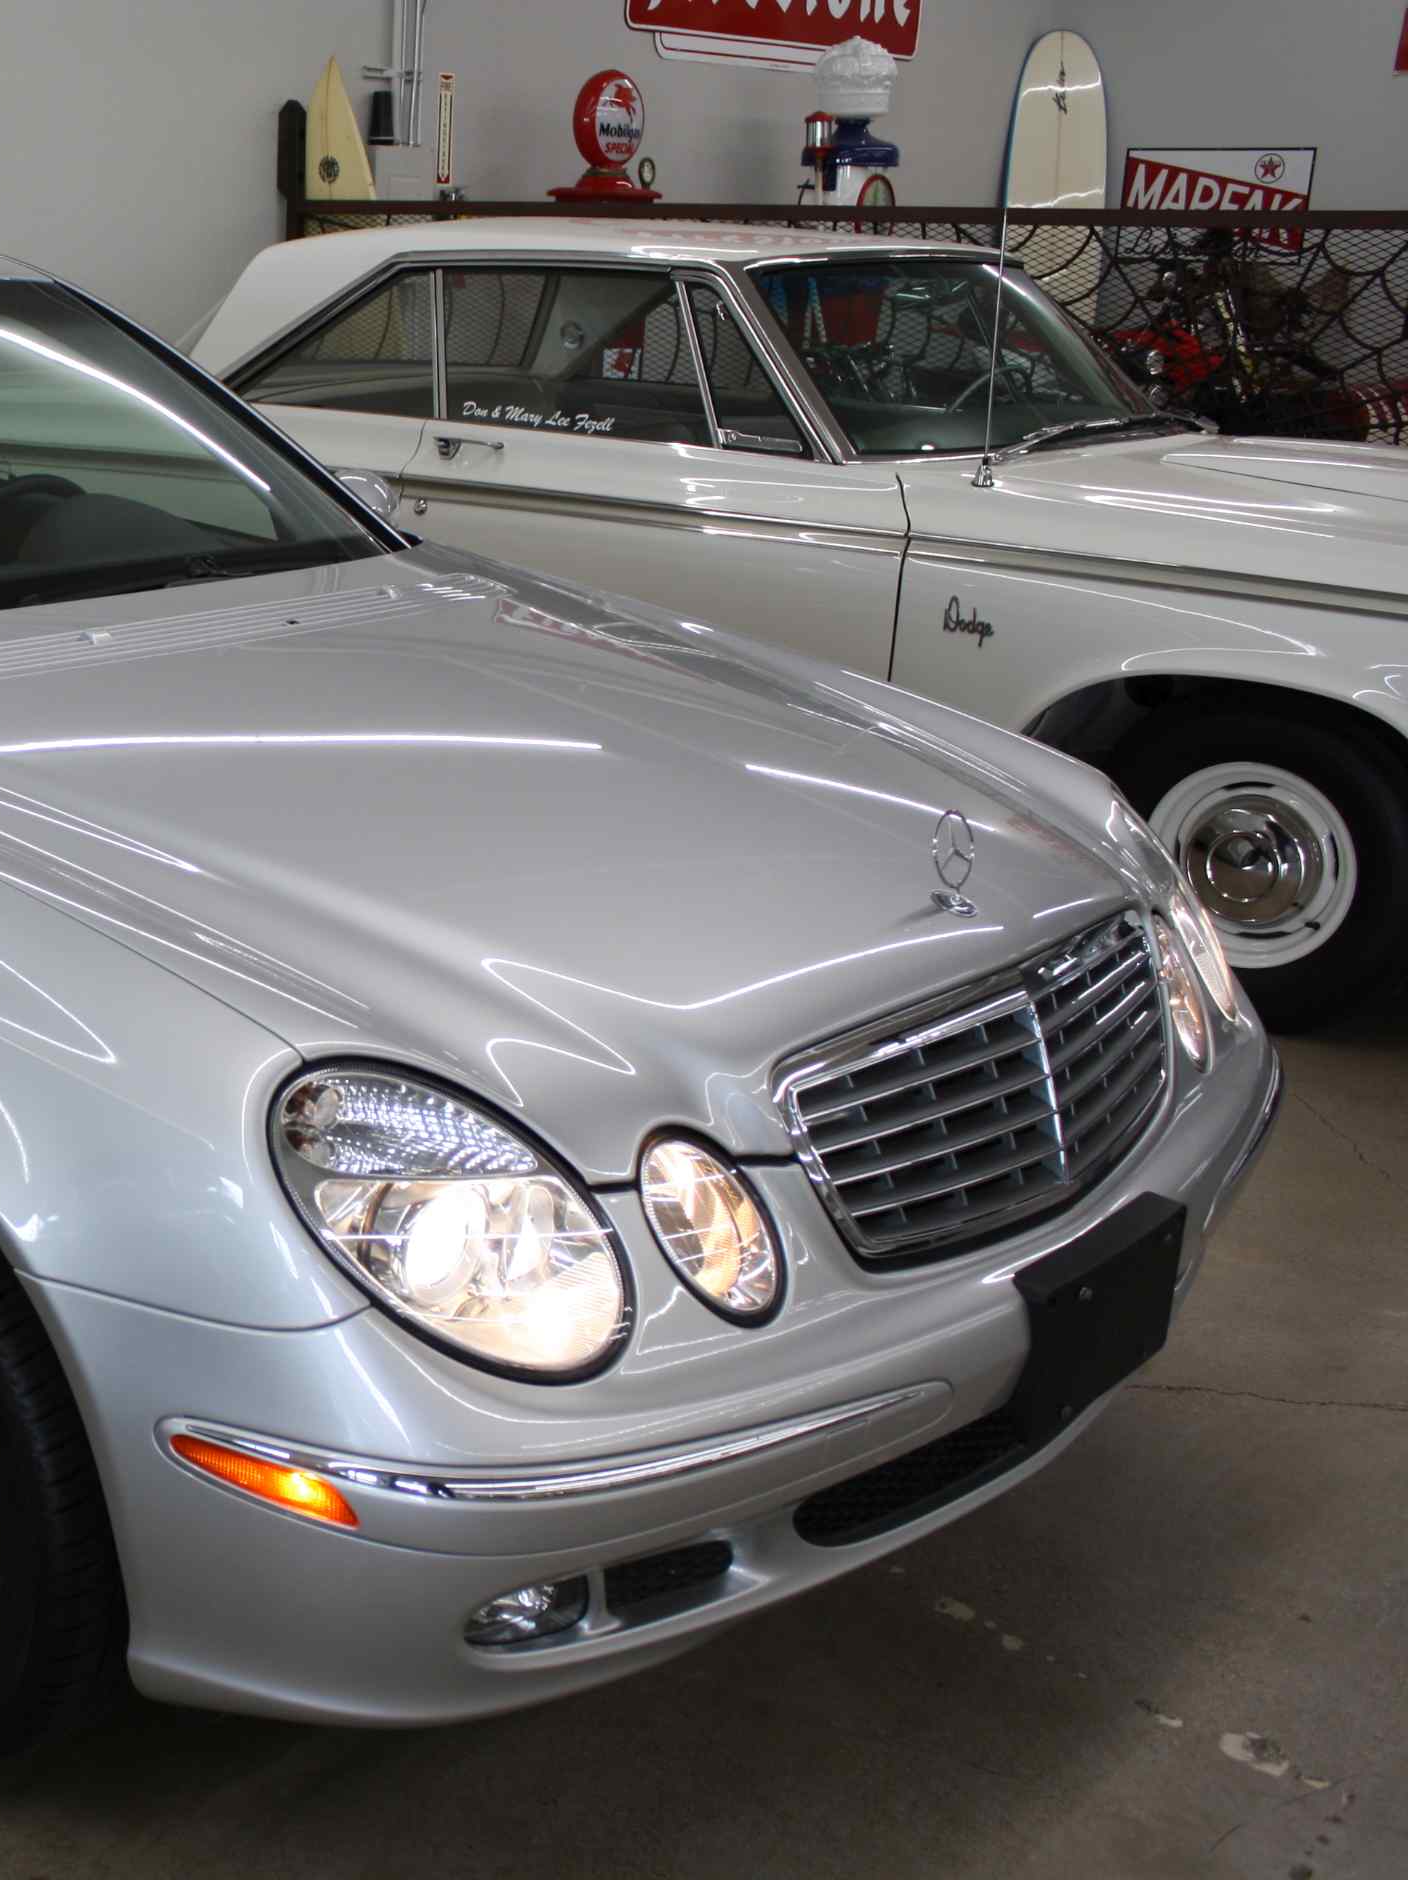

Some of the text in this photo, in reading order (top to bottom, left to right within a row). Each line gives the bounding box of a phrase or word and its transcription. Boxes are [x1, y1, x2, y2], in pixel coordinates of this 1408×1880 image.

[462, 401, 488, 416] Don
[491, 405, 502, 418] &
[505, 405, 543, 427] Mary
[544, 410, 571, 426] Lee
[943, 594, 994, 649] Dodge
